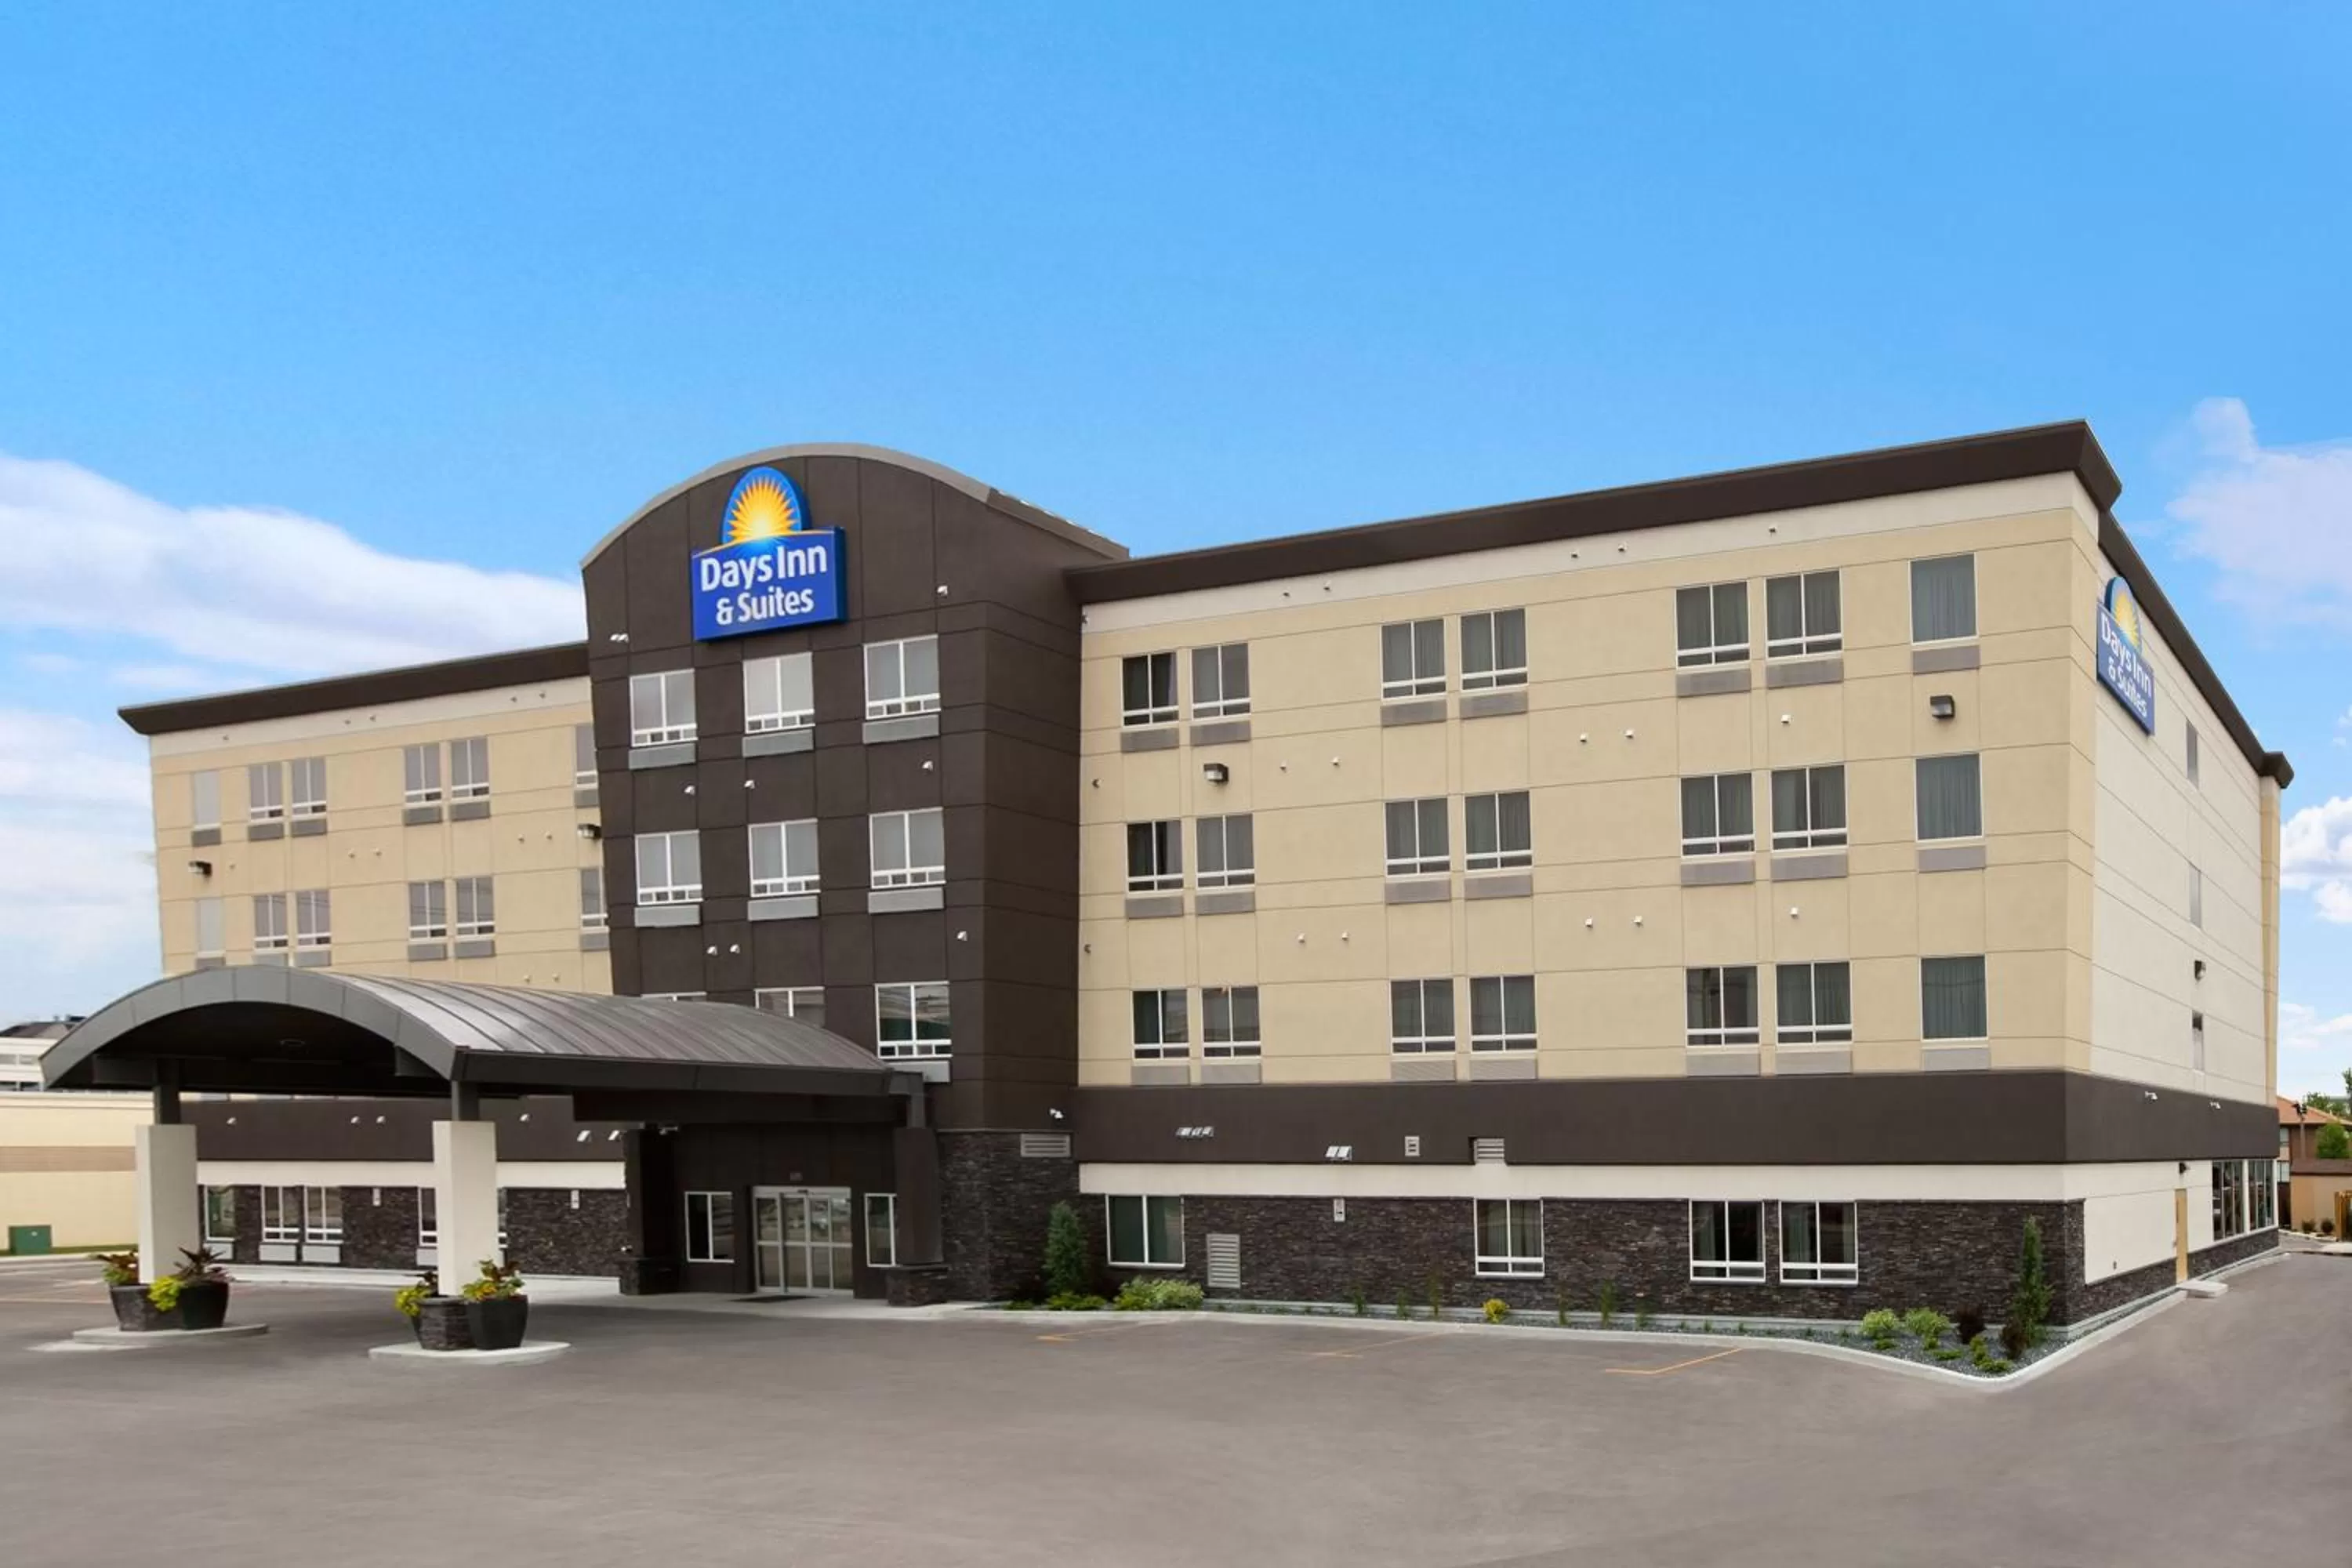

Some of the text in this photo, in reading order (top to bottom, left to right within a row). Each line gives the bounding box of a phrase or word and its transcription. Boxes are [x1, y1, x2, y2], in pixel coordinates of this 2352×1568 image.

[700, 545, 827, 591] Days Inn
[717, 586, 815, 625] & Suites
[2100, 612, 2153, 697] Days Inn
[2118, 665, 2148, 717] Suites
